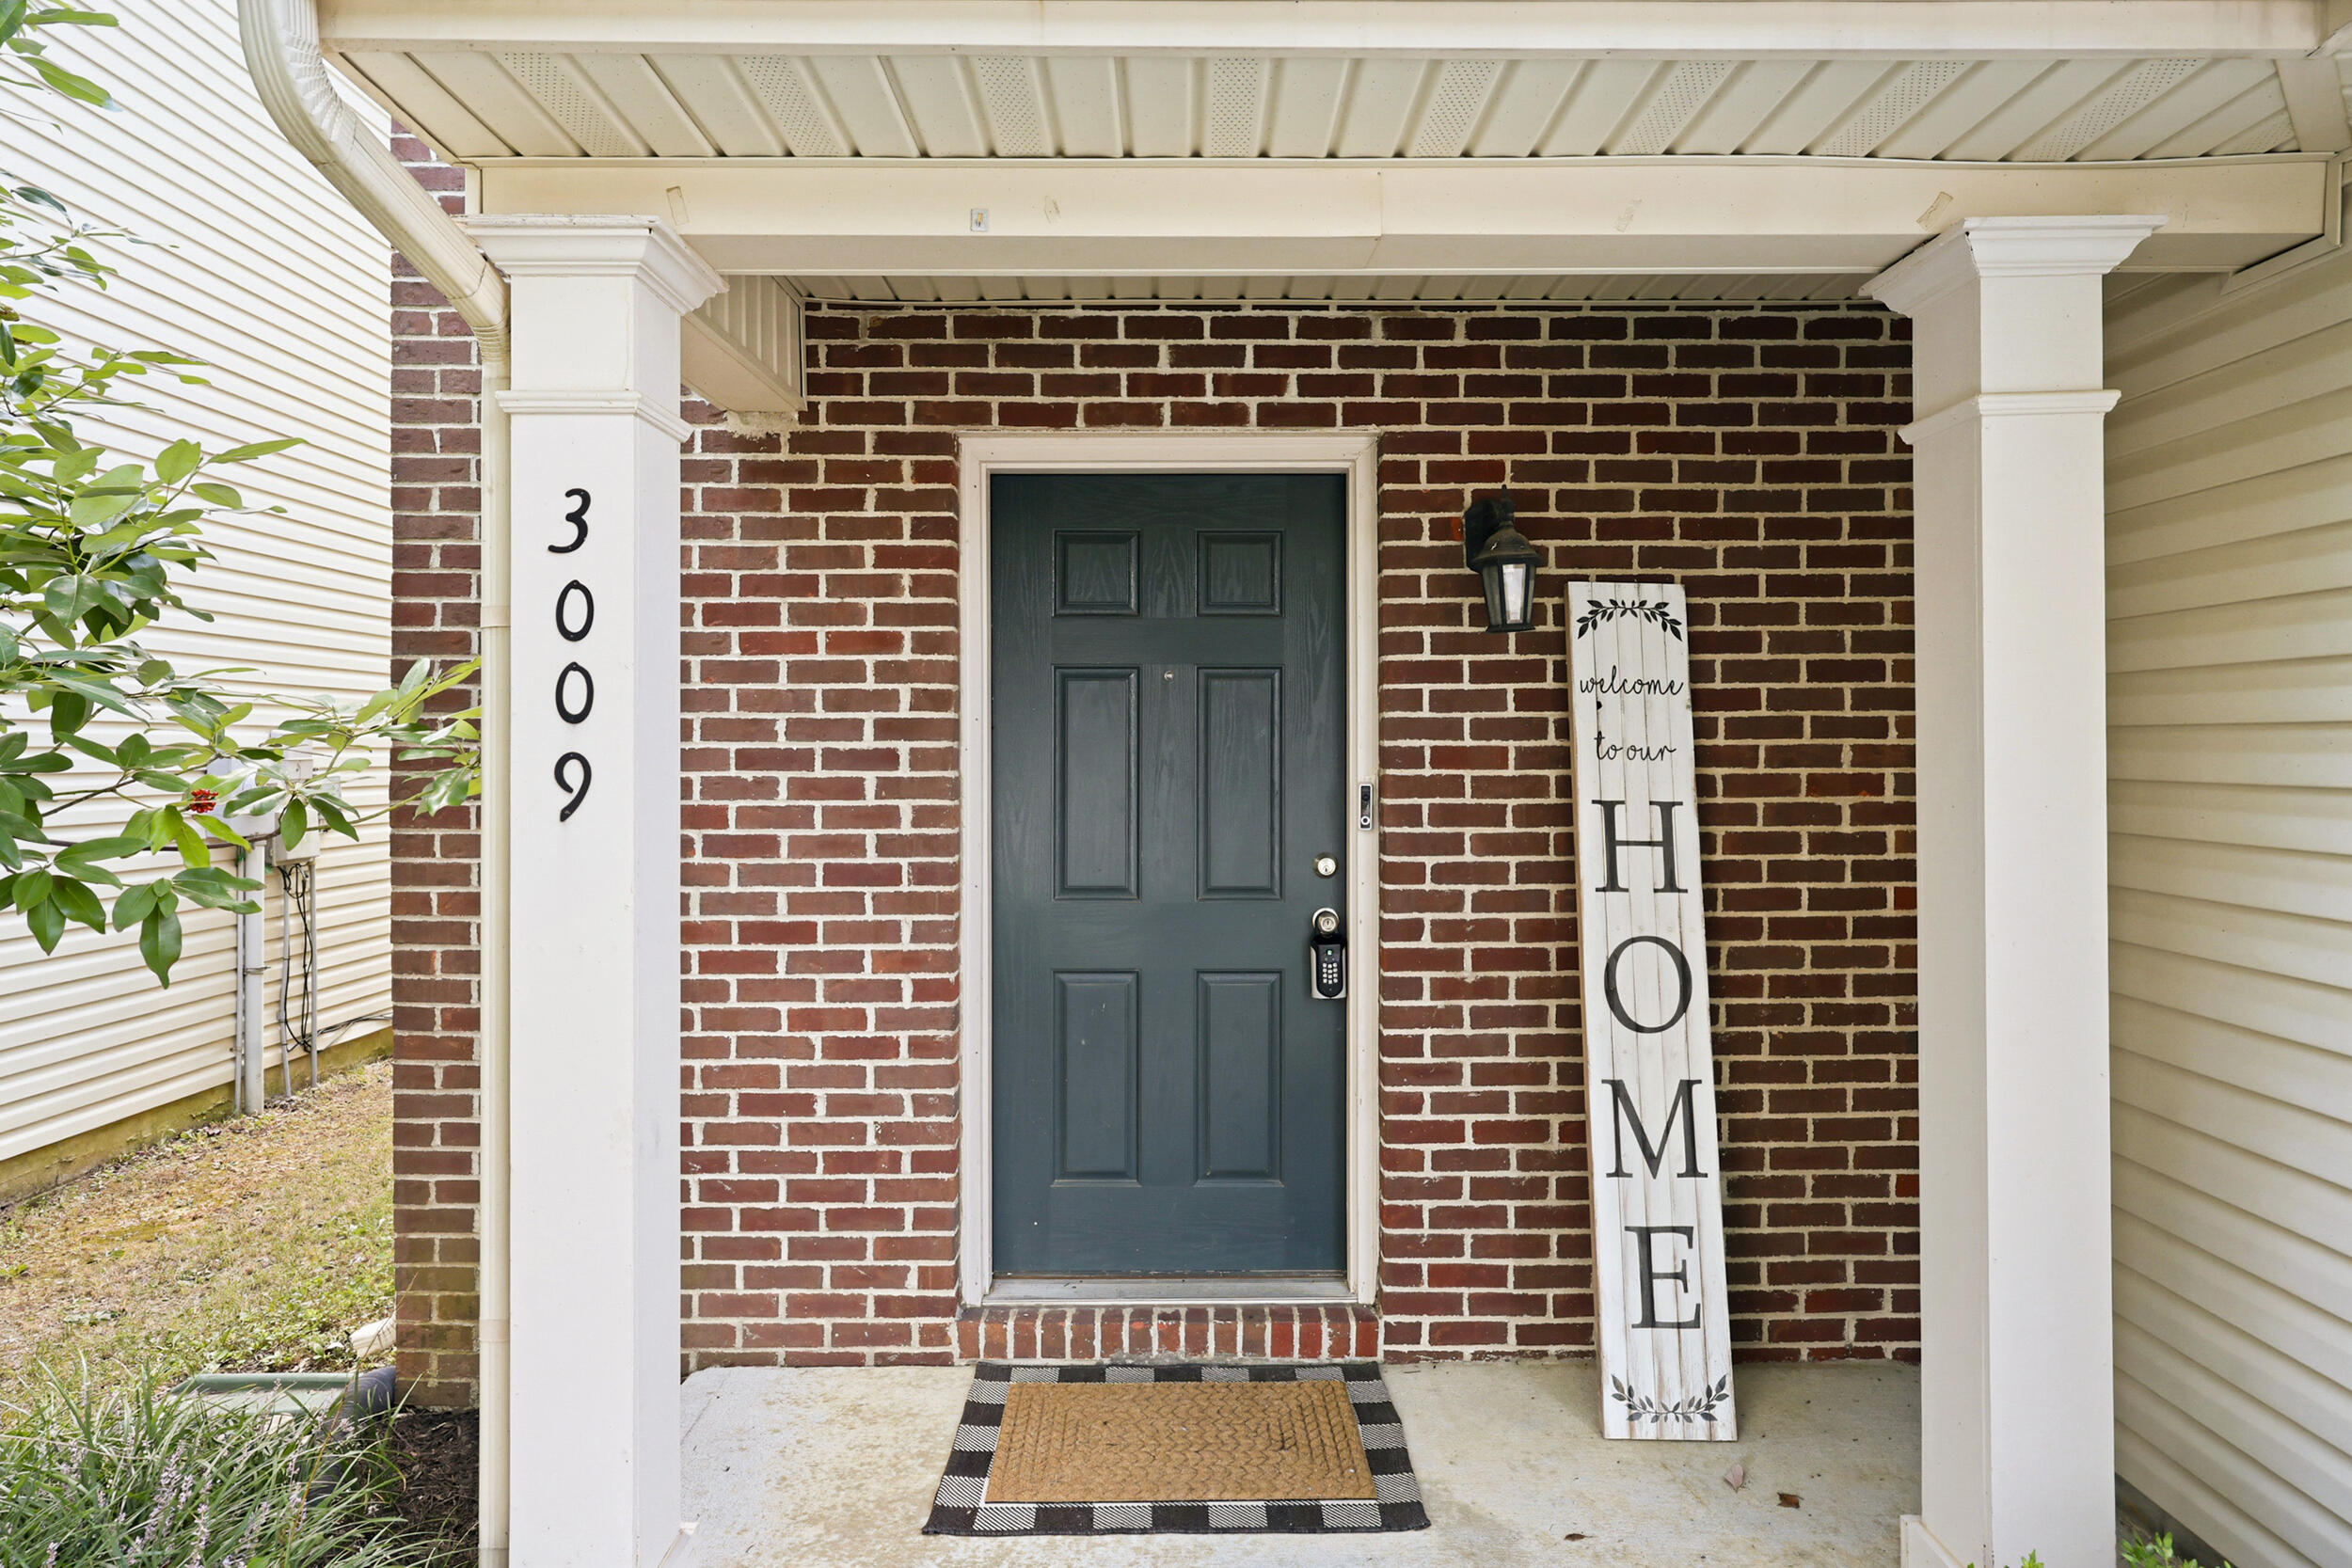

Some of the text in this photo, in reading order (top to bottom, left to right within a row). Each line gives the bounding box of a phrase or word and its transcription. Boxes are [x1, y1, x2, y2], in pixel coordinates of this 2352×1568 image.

[548, 487, 595, 822] 3009
[1580, 664, 1684, 696] welcome
[1594, 730, 1677, 761] to our
[1591, 800, 1708, 1329] HOME
